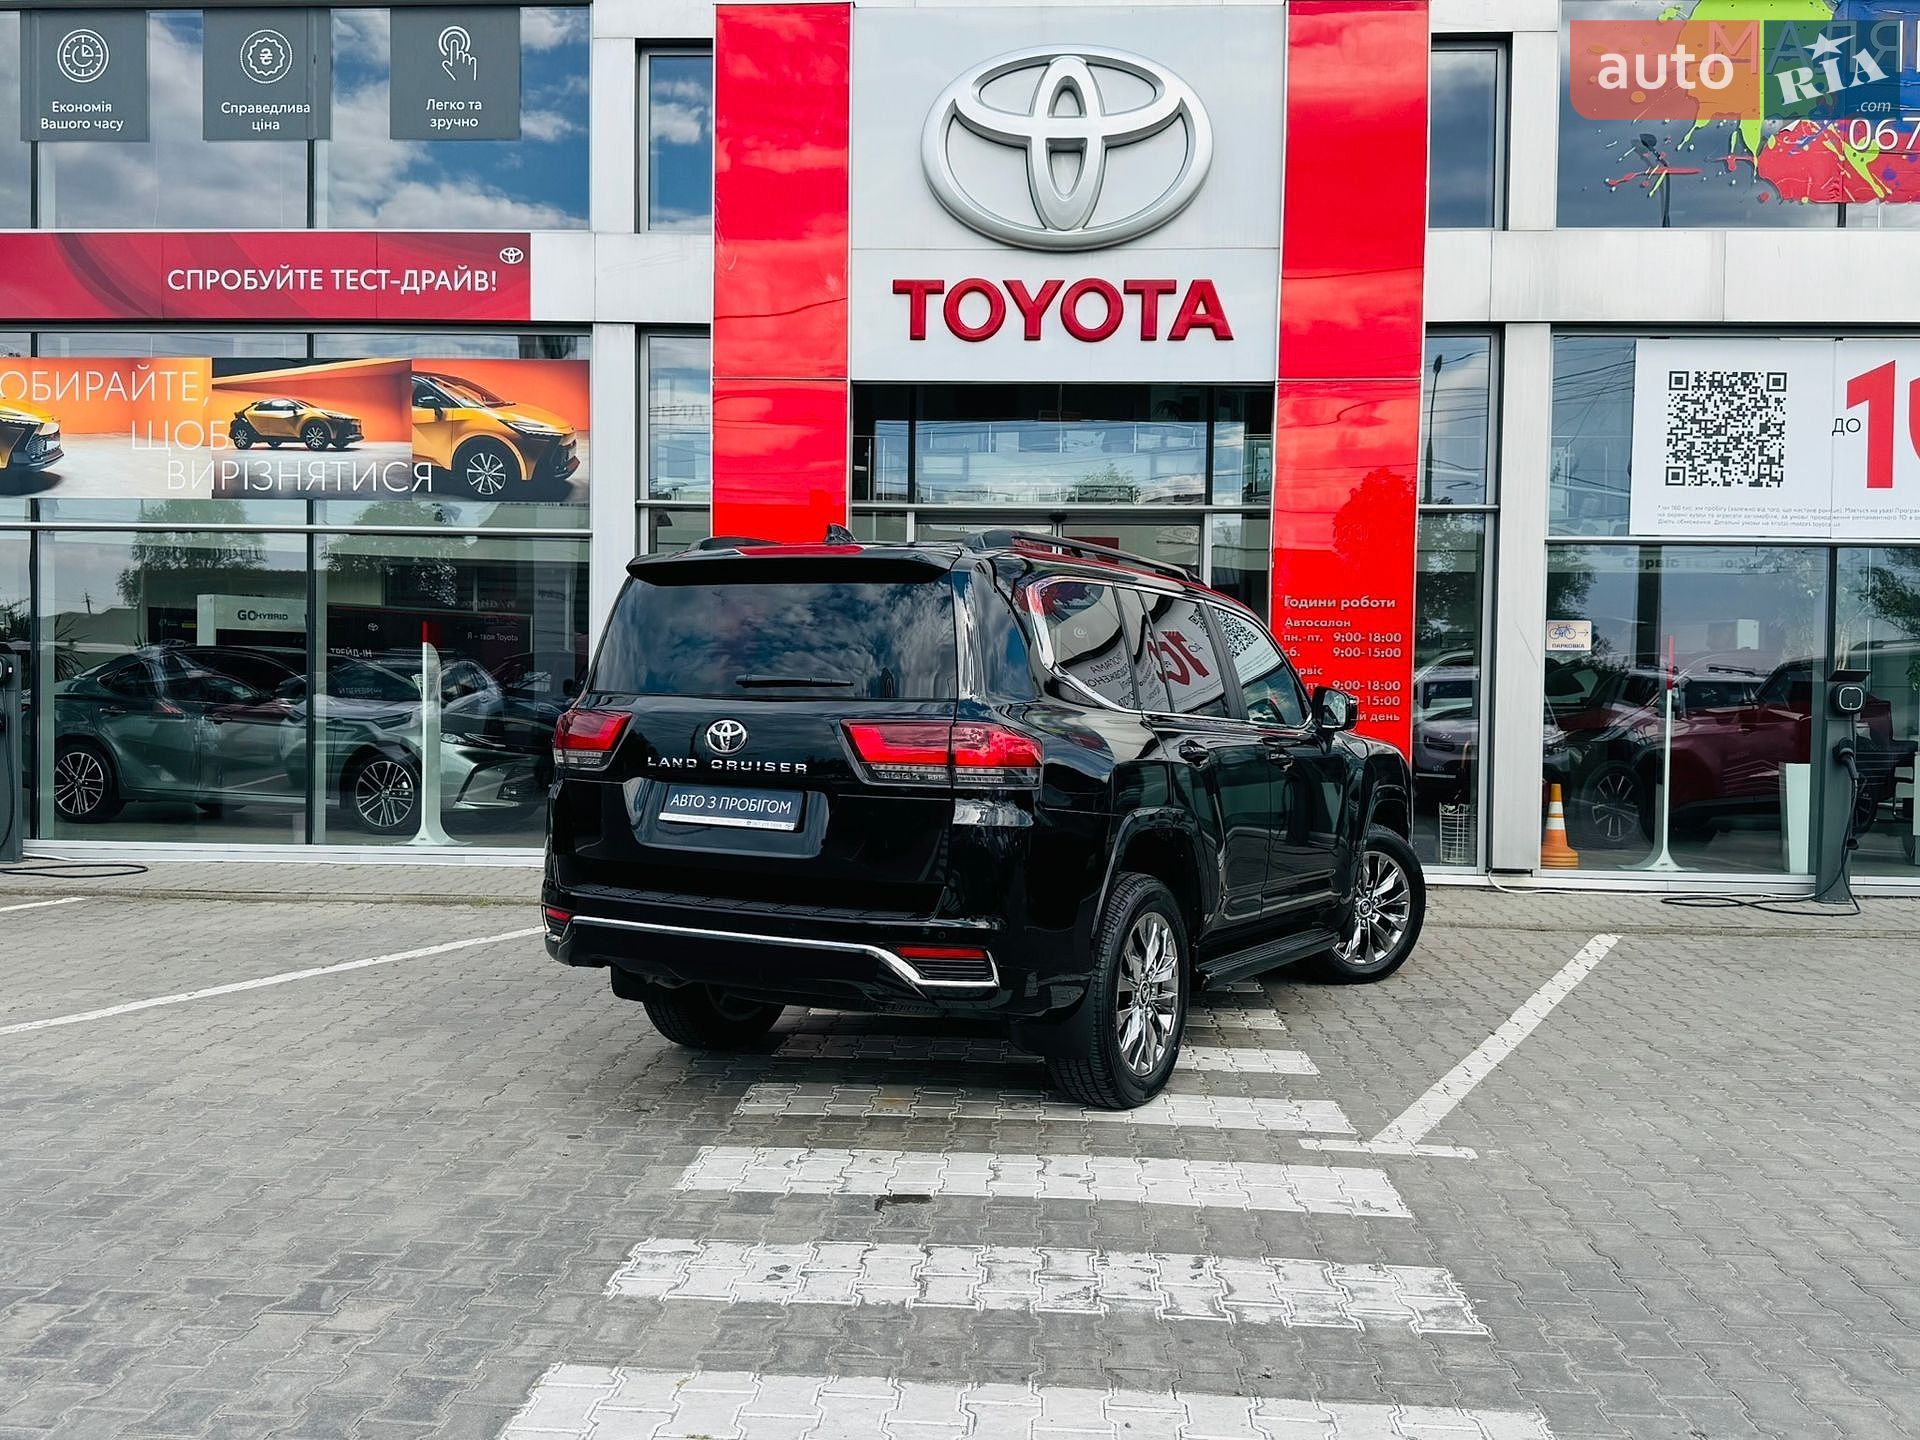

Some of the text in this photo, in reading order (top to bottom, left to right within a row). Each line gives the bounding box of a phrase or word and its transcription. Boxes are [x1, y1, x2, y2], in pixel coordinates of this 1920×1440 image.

[52, 101, 112, 113] Економія
[221, 102, 311, 116] Справедлива
[426, 98, 482, 111] Легко та
[41, 118, 124, 133] Вашого часу
[252, 118, 280, 132] ціна
[430, 118, 479, 130] зручно
[1849, 118, 1920, 151] 067
[167, 264, 498, 295] СПРОБУЙТЕ ТЕСТ-ДРАЙВ!
[892, 277, 1234, 343] TOYOTA
[1846, 360, 1920, 489] 1
[131, 420, 229, 456] ЩОБ
[167, 461, 433, 492] ВИРІЗНЯТИСЯ
[1284, 595, 1396, 610] Години роботи
[1284, 617, 1351, 627] Автосалон
[1298, 664, 1324, 678] рвіс
[1370, 713, 1400, 723] день
[647, 756, 808, 775] LAND CRUISER
[670, 794, 706, 808] АВТО
[718, 796, 792, 815] ПРОБІГОМ
